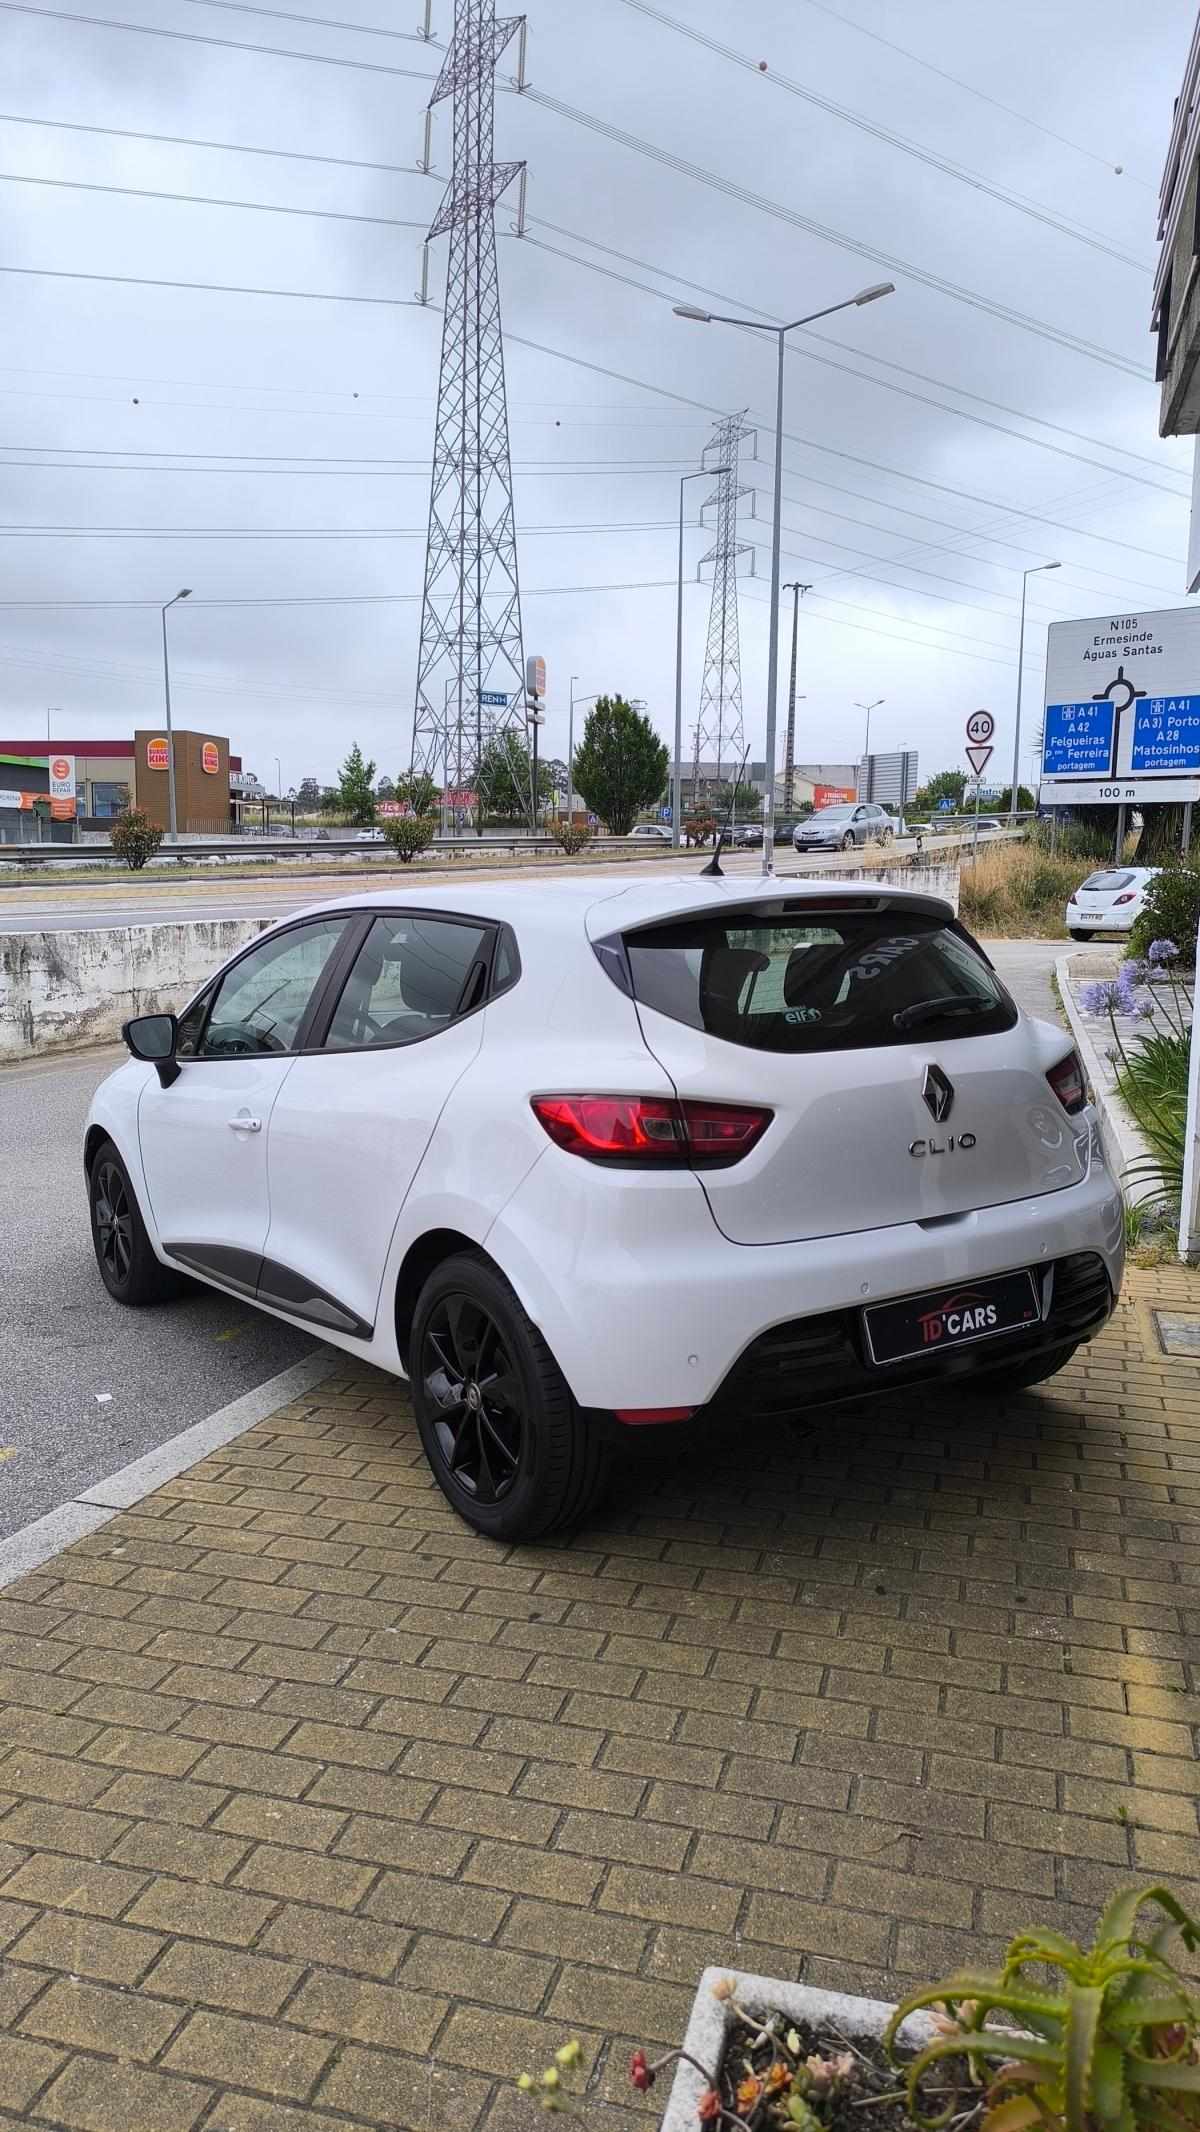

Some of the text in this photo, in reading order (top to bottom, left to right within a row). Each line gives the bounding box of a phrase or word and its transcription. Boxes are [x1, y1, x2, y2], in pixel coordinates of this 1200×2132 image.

[1093, 632, 1153, 646] Ermesinde
[1083, 645, 1163, 661] Águas Santas
[970, 720, 990, 733] 40
[1167, 716, 1200, 727] Porto
[1050, 736, 1105, 748] Felgueiras
[1068, 748, 1109, 759] Ferreira
[1134, 744, 1200, 756] Matosinhos
[1057, 762, 1095, 770] portagem
[1144, 759, 1186, 768] portagem
[1099, 788, 1120, 797] 100
[663, 808, 670, 817] P
[908, 1132, 977, 1158] CLIO
